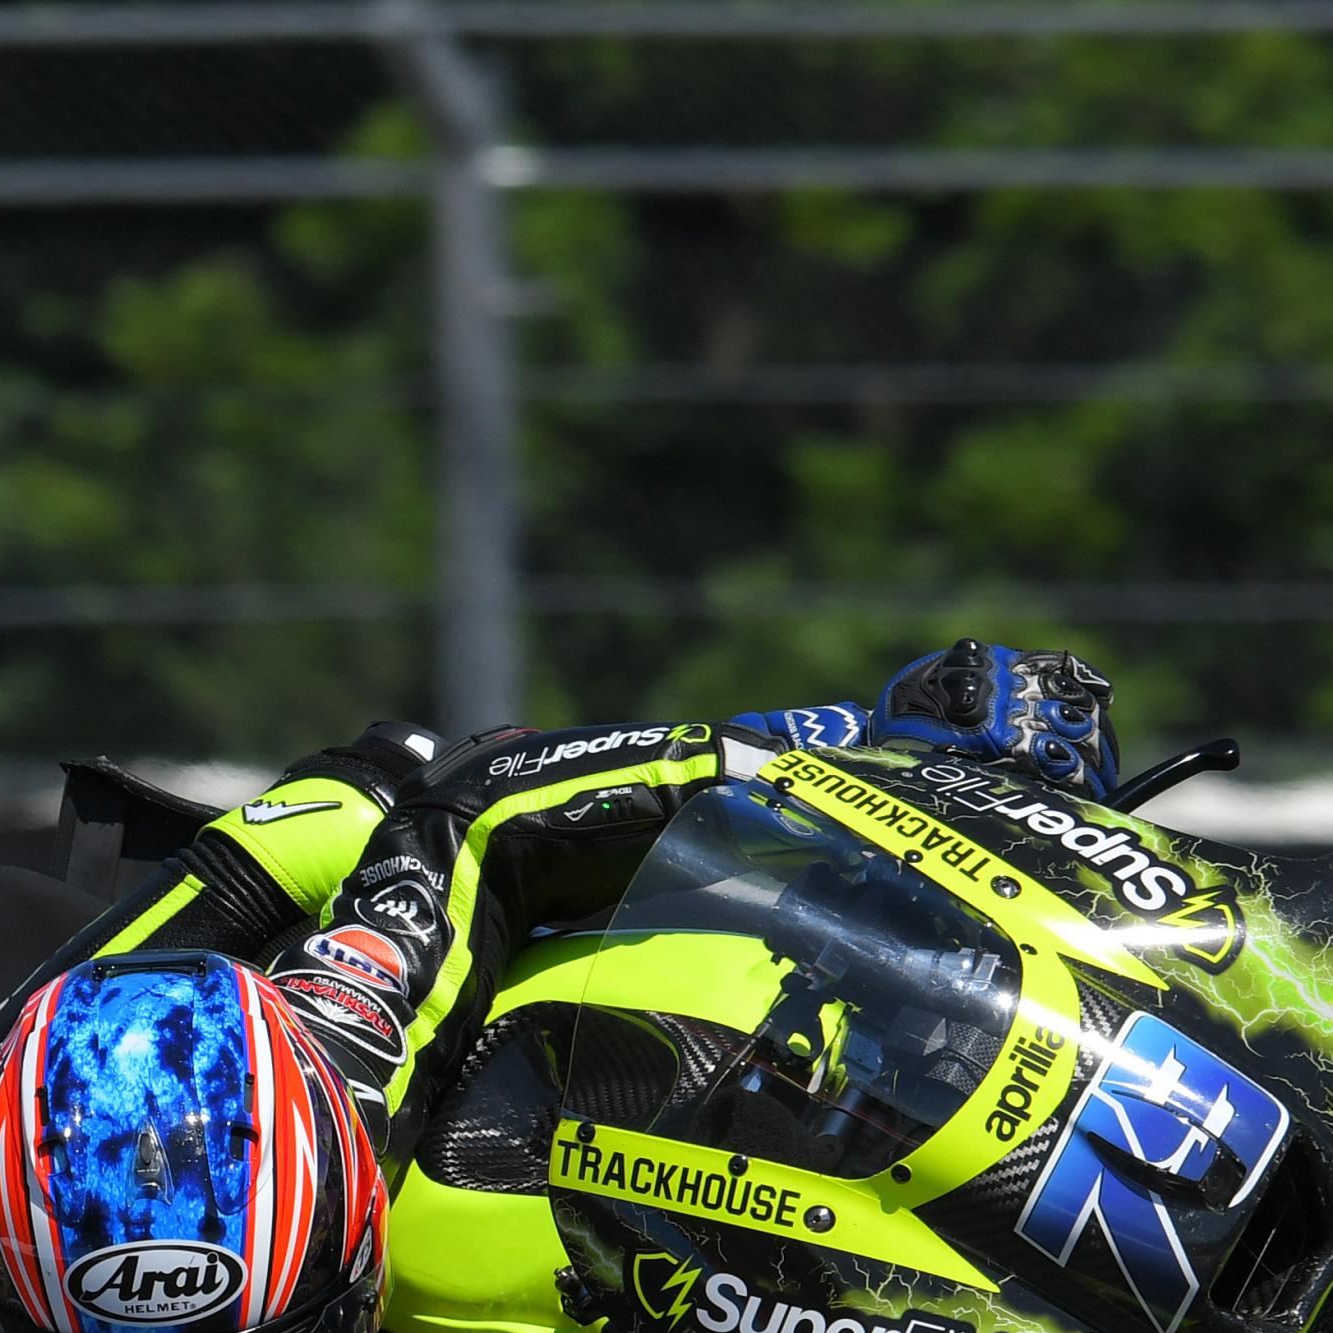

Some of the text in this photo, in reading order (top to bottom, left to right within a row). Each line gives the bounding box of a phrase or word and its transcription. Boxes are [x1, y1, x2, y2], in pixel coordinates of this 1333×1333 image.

[489, 725, 671, 779] SuperFile
[772, 752, 991, 882] TRACKHOUSE
[920, 763, 1189, 913] SuperFile
[360, 855, 447, 892] TRCKHOUSE
[985, 1020, 1066, 1142] aprilia
[556, 1139, 803, 1228] TRACKHOUSE
[79, 1251, 225, 1303] Arai
[124, 1302, 190, 1314] HELMET
